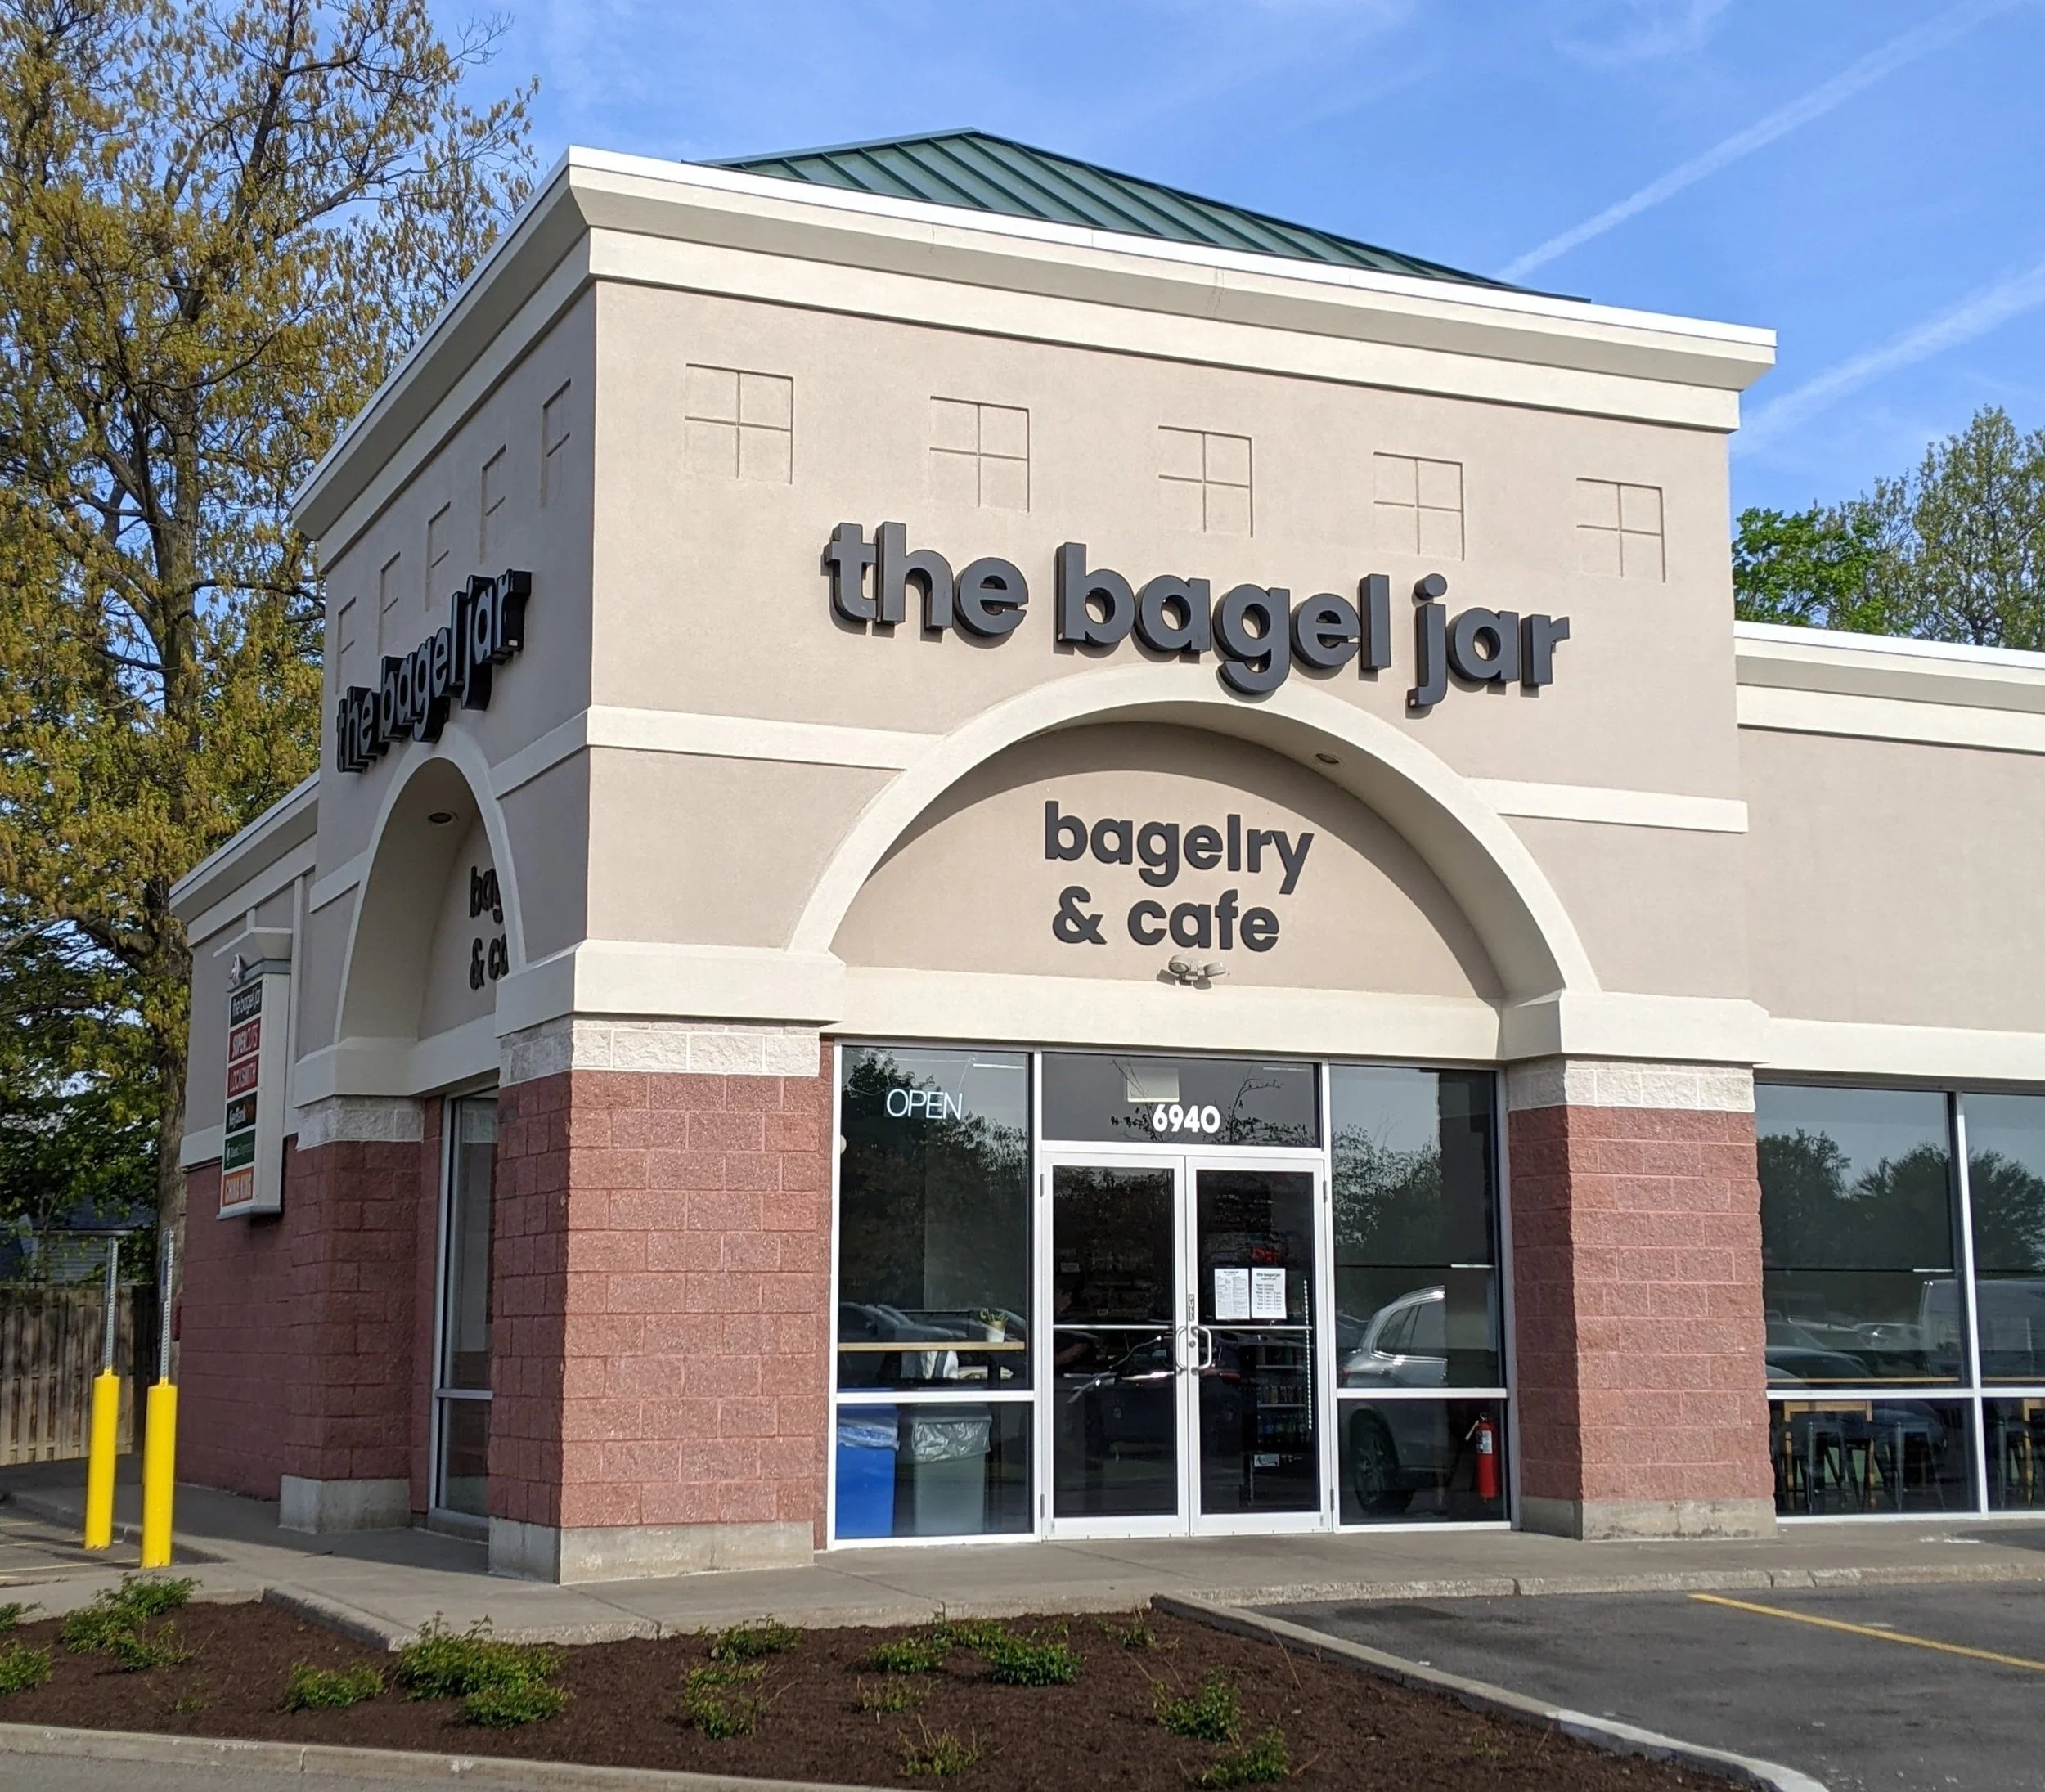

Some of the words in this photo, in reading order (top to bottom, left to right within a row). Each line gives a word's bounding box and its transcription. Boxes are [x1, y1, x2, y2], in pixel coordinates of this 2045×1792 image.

[823, 521, 1029, 637] the
[1055, 541, 1391, 694] bagel
[1407, 573, 1570, 707] jar
[336, 685, 381, 773] the
[378, 591, 464, 743] bagel
[460, 569, 530, 711] jar
[1045, 801, 1315, 895] bagelry
[1052, 885, 1108, 945] &
[1127, 889, 1279, 952] cafe
[469, 937, 484, 990] &
[886, 1089, 963, 1120] OPEN
[1153, 1103, 1220, 1134] 6940
